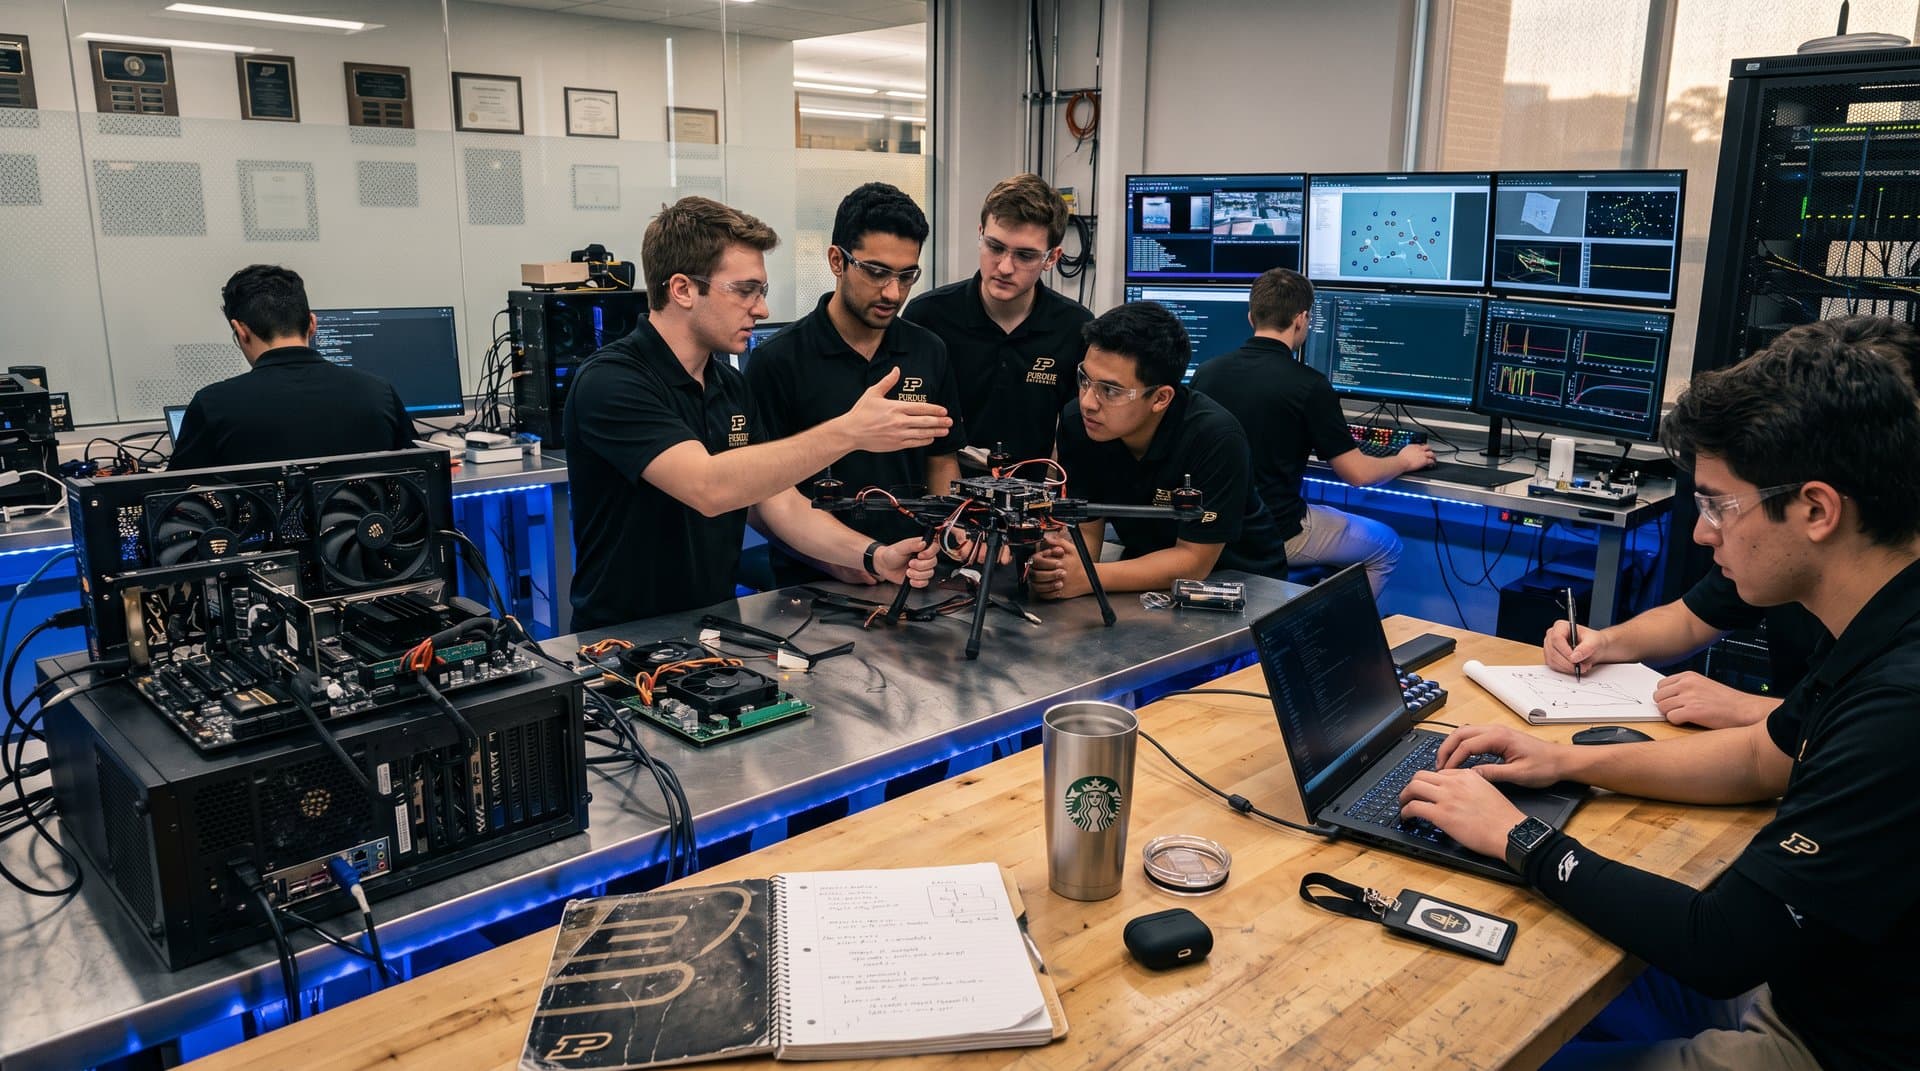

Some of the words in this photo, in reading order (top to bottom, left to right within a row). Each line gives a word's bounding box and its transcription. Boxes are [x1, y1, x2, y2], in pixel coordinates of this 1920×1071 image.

[1033, 357, 1056, 371] P
[903, 377, 923, 392] P
[731, 414, 746, 432] P
[1779, 832, 1820, 855] P
[544, 1031, 613, 1061] P
